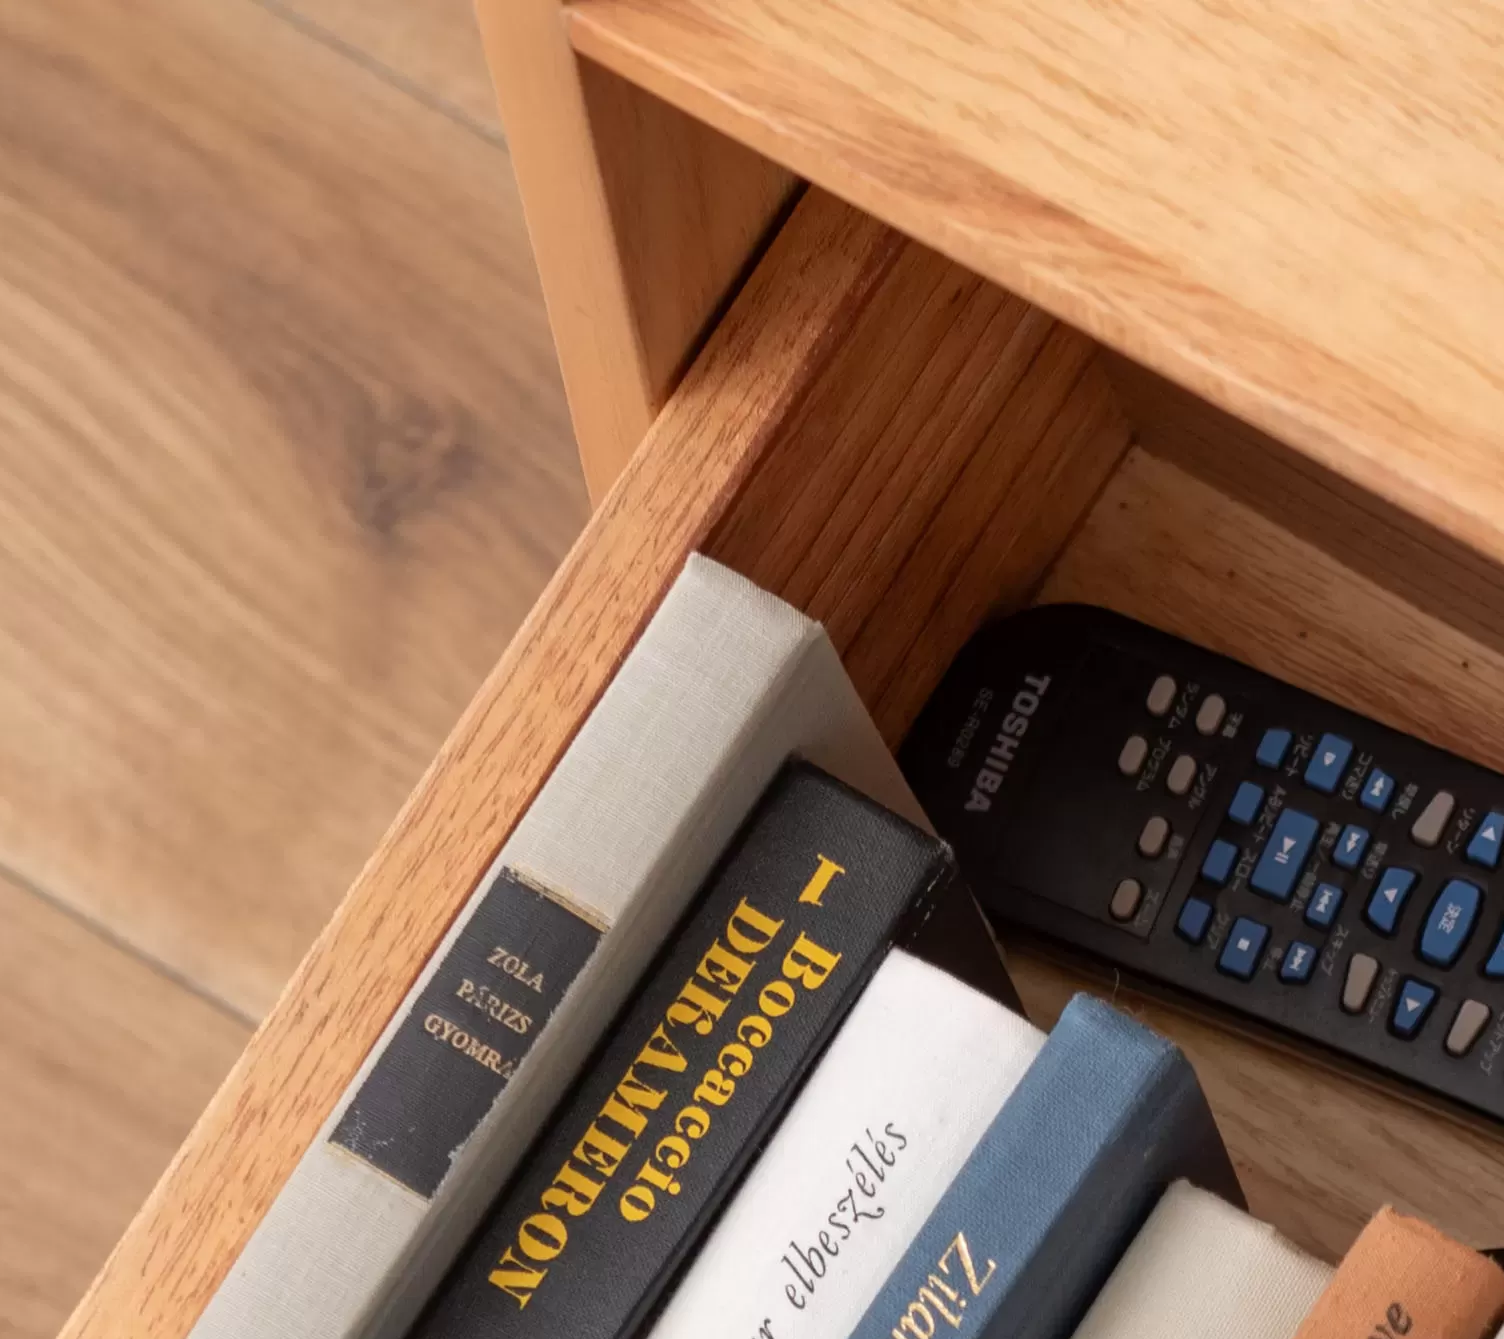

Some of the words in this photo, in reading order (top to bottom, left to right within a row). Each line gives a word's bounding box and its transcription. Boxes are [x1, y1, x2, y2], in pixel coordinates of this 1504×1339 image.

[963, 673, 1052, 812] TOSHIBA
[487, 946, 543, 993] ZOLA
[1438, 903, 1462, 934] 決定
[456, 978, 532, 1033] PÁRIZS
[489, 897, 785, 1310] DEKAMERON
[620, 931, 842, 1221] Boccaccio
[781, 1123, 907, 1310] elbeszélés
